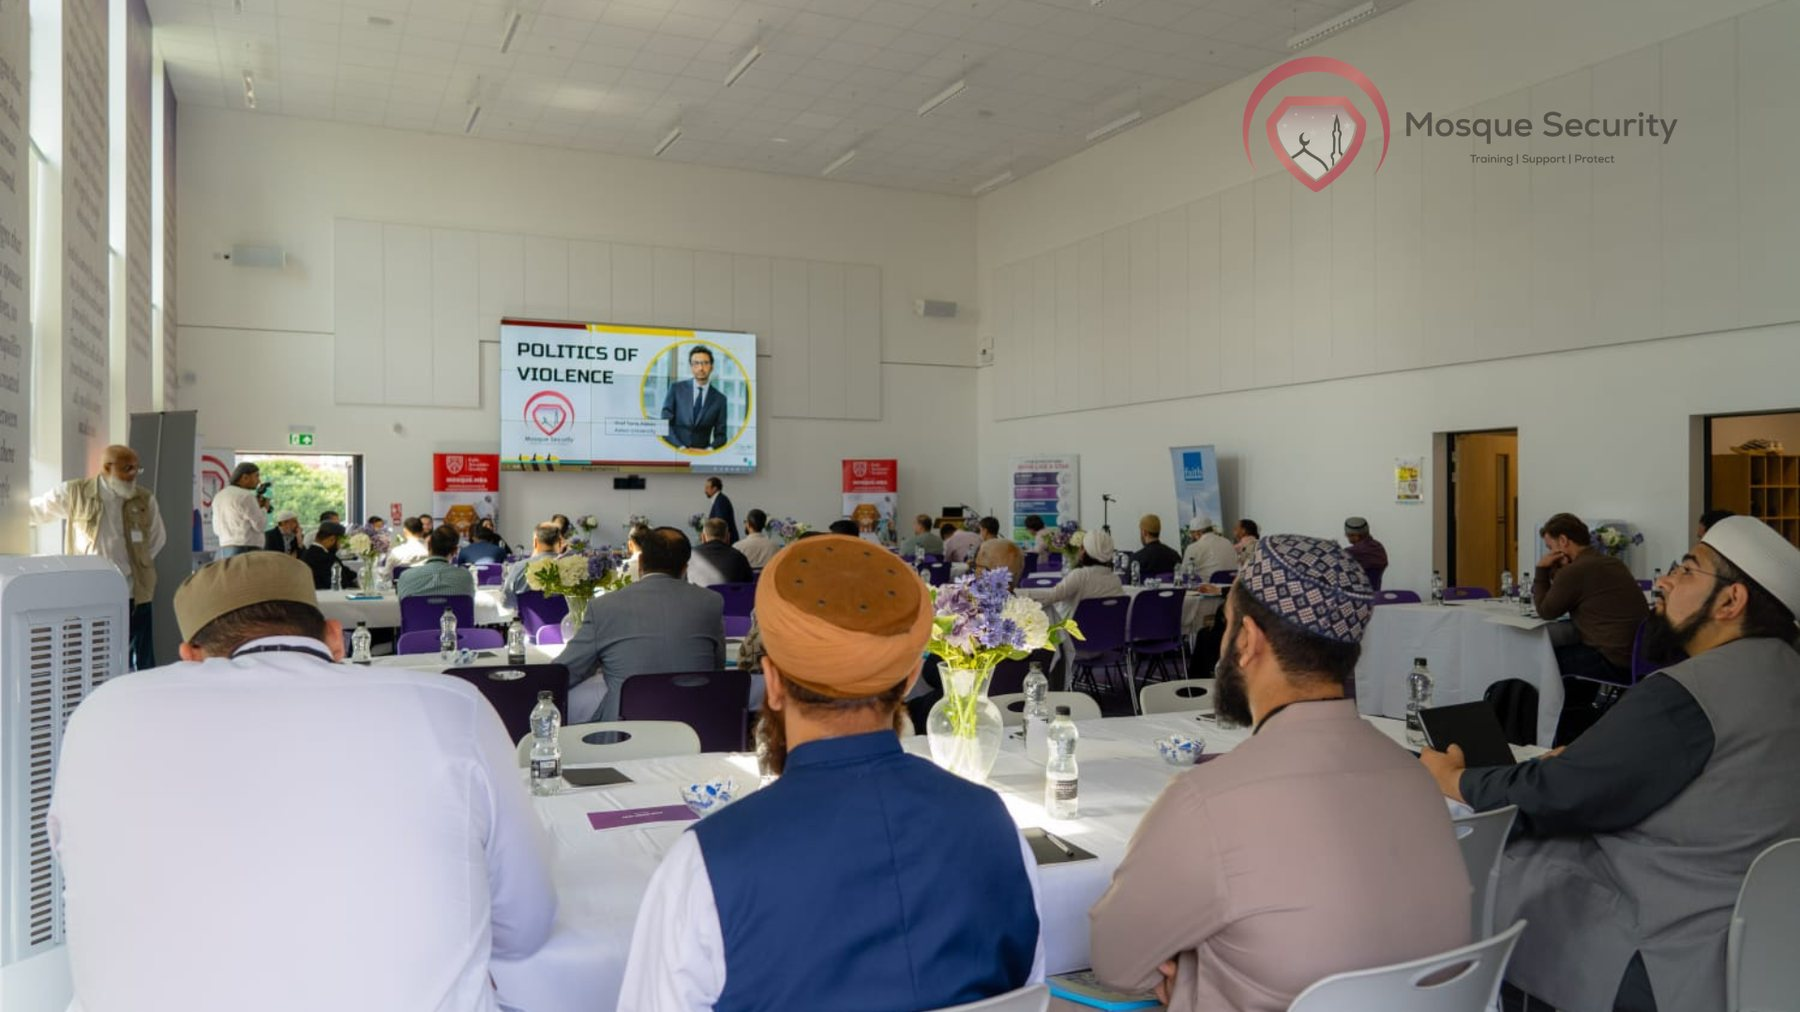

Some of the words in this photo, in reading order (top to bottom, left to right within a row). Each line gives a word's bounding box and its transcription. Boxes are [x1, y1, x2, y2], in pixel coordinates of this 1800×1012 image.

[517, 342, 608, 361] POLITICS
[614, 347, 639, 362] OF
[516, 366, 614, 385] VIOLENCE
